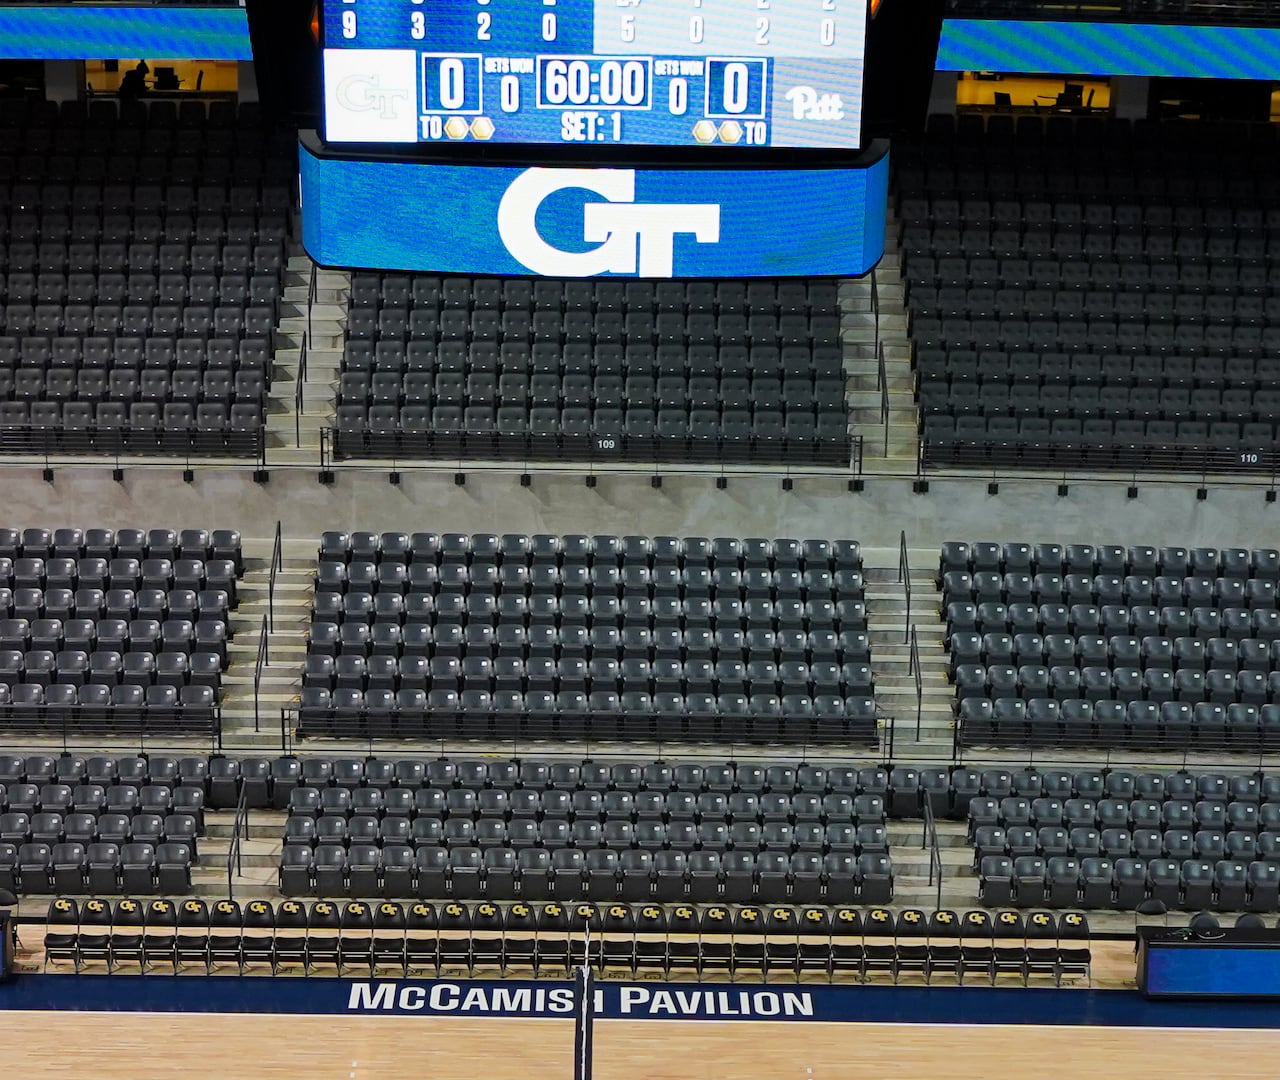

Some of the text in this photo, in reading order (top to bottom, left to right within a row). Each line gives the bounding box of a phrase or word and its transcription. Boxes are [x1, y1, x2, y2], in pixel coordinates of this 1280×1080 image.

[342, 10, 357, 39] 9
[411, 11, 425, 40] 3
[477, 12, 491, 40] 2
[542, 13, 557, 41] 0
[621, 15, 635, 42] 5
[689, 16, 704, 44] 0
[755, 17, 769, 45] 2
[821, 18, 835, 46] 0
[439, 58, 464, 109] 0
[500, 75, 519, 113] 0
[545, 60, 645, 105] 60:00
[669, 77, 688, 116] 0
[723, 63, 748, 114] 0
[419, 116, 442, 139] TO
[561, 111, 621, 142] SET: 1
[744, 121, 767, 145] TO
[497, 166, 721, 278] GT
[597, 440, 615, 449] 109
[1240, 453, 1258, 463] 110
[620, 987, 814, 1016] PAVILION
